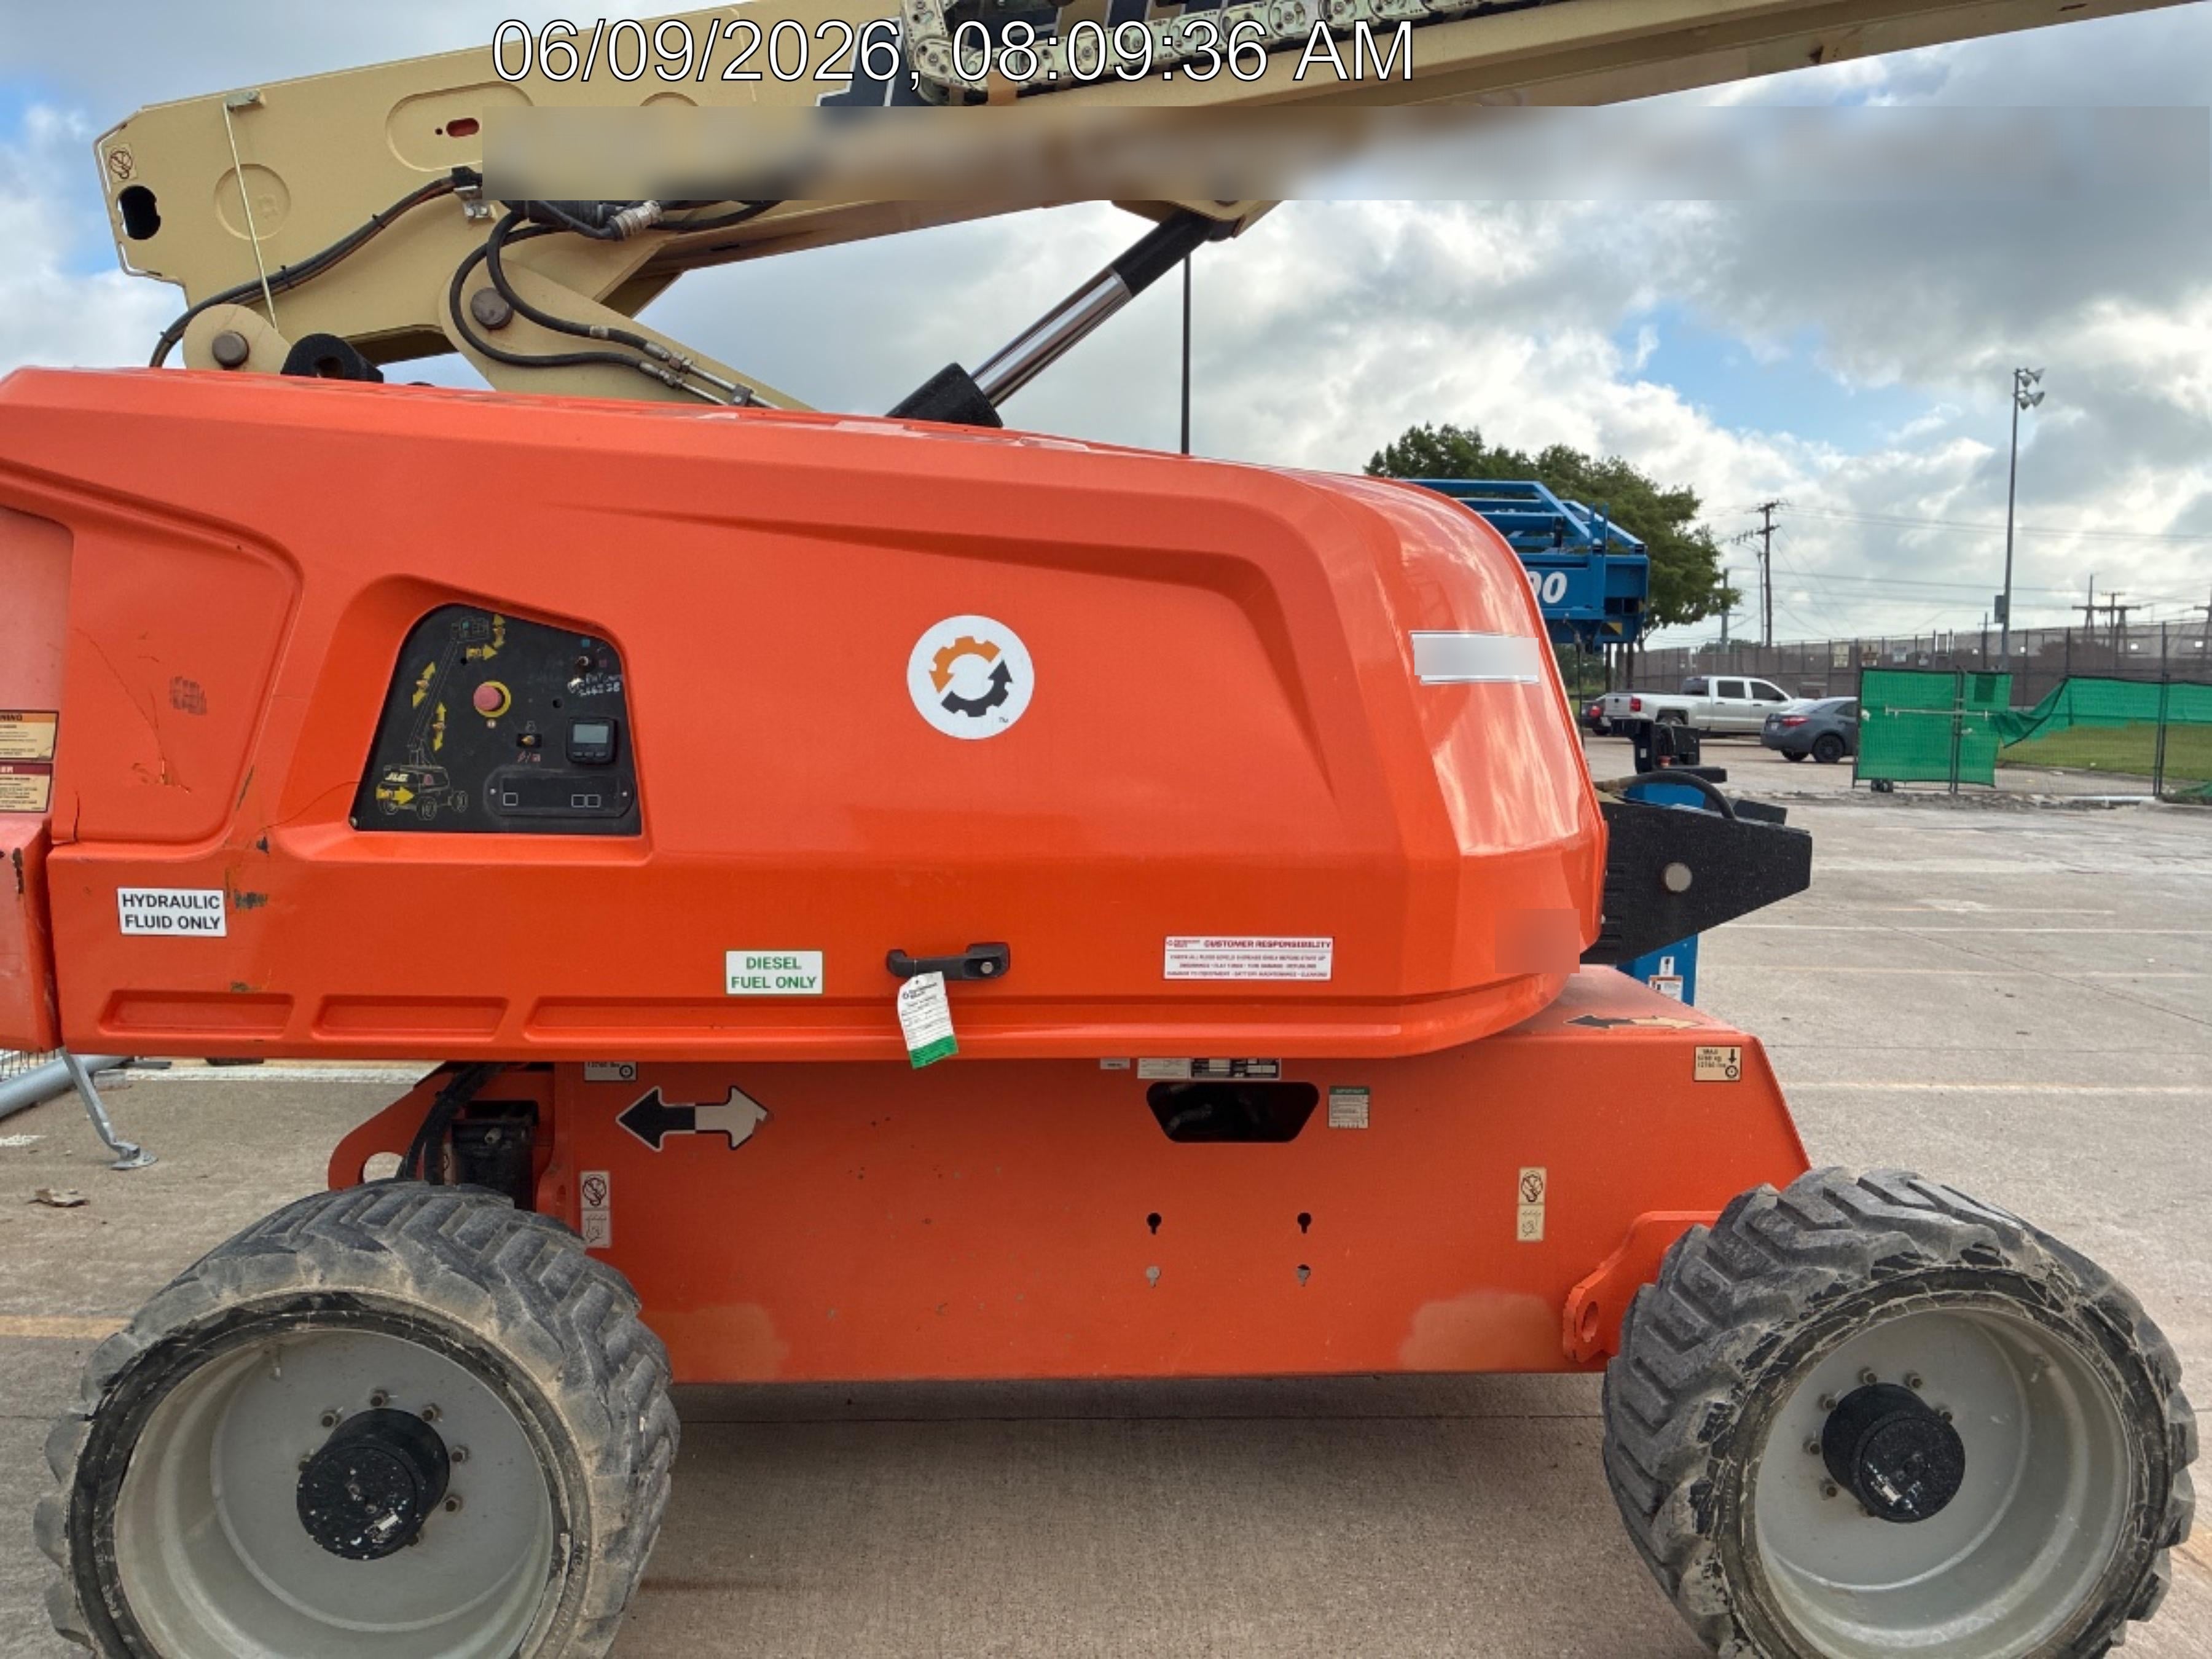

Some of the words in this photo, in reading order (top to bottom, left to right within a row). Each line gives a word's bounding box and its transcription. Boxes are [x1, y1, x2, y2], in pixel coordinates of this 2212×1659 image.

[122, 893, 221, 910] HYDRAULIC
[125, 914, 173, 928] FLUID
[178, 916, 221, 930] ONLY
[745, 957, 802, 970] DIESEL
[731, 976, 771, 989] FUEL
[775, 976, 817, 989] ONLY
